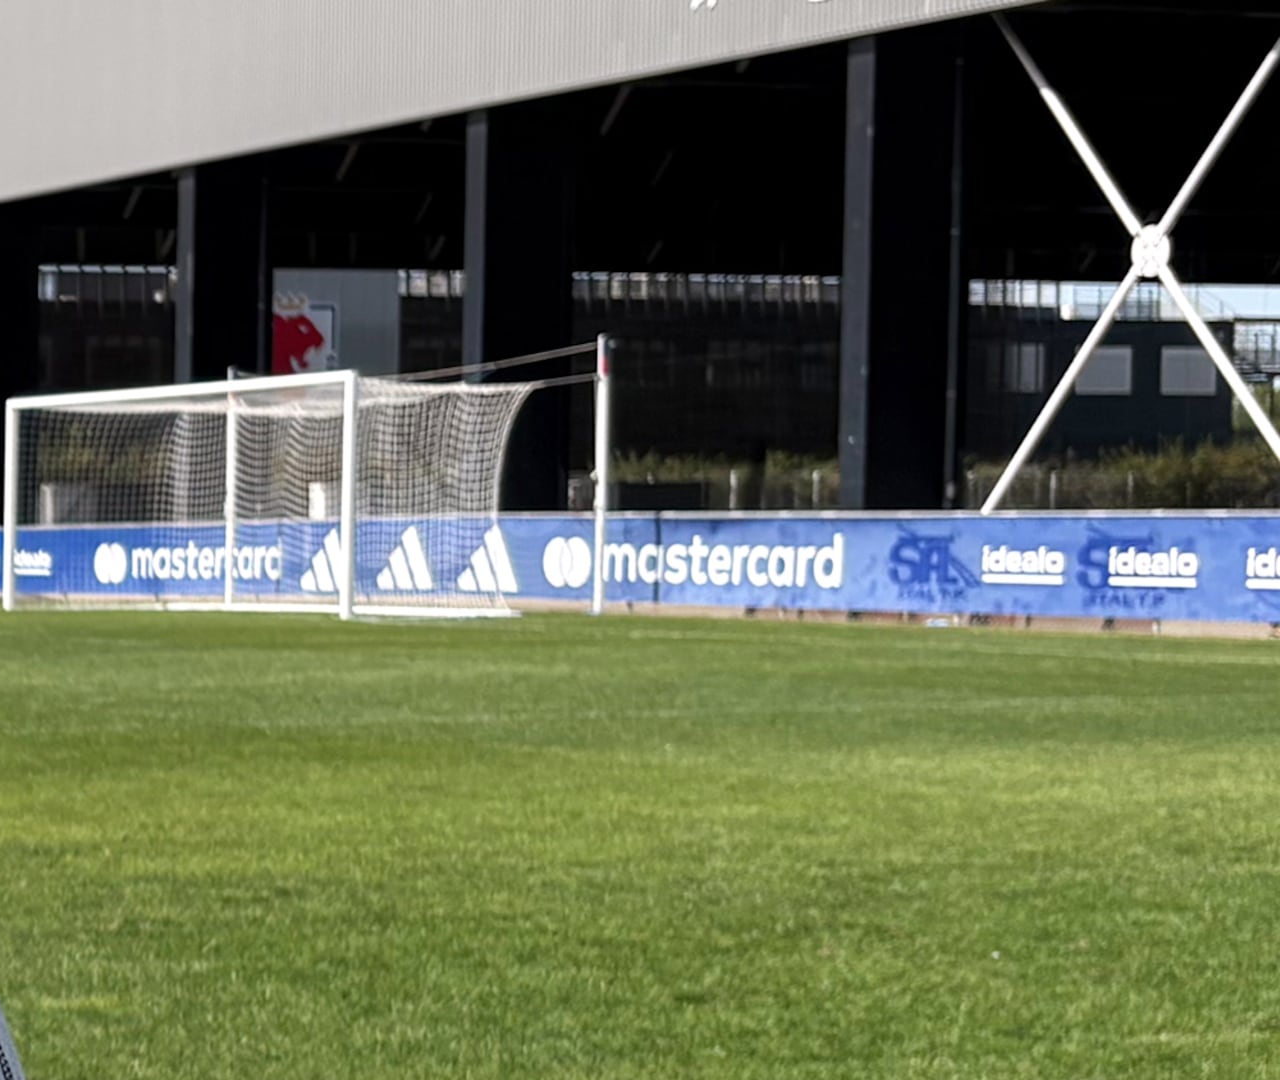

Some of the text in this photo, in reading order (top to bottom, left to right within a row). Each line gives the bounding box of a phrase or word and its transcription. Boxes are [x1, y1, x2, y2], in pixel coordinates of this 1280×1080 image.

[602, 533, 844, 589] mastercard
[981, 544, 1066, 574] idealo
[1108, 545, 1199, 577] idealo
